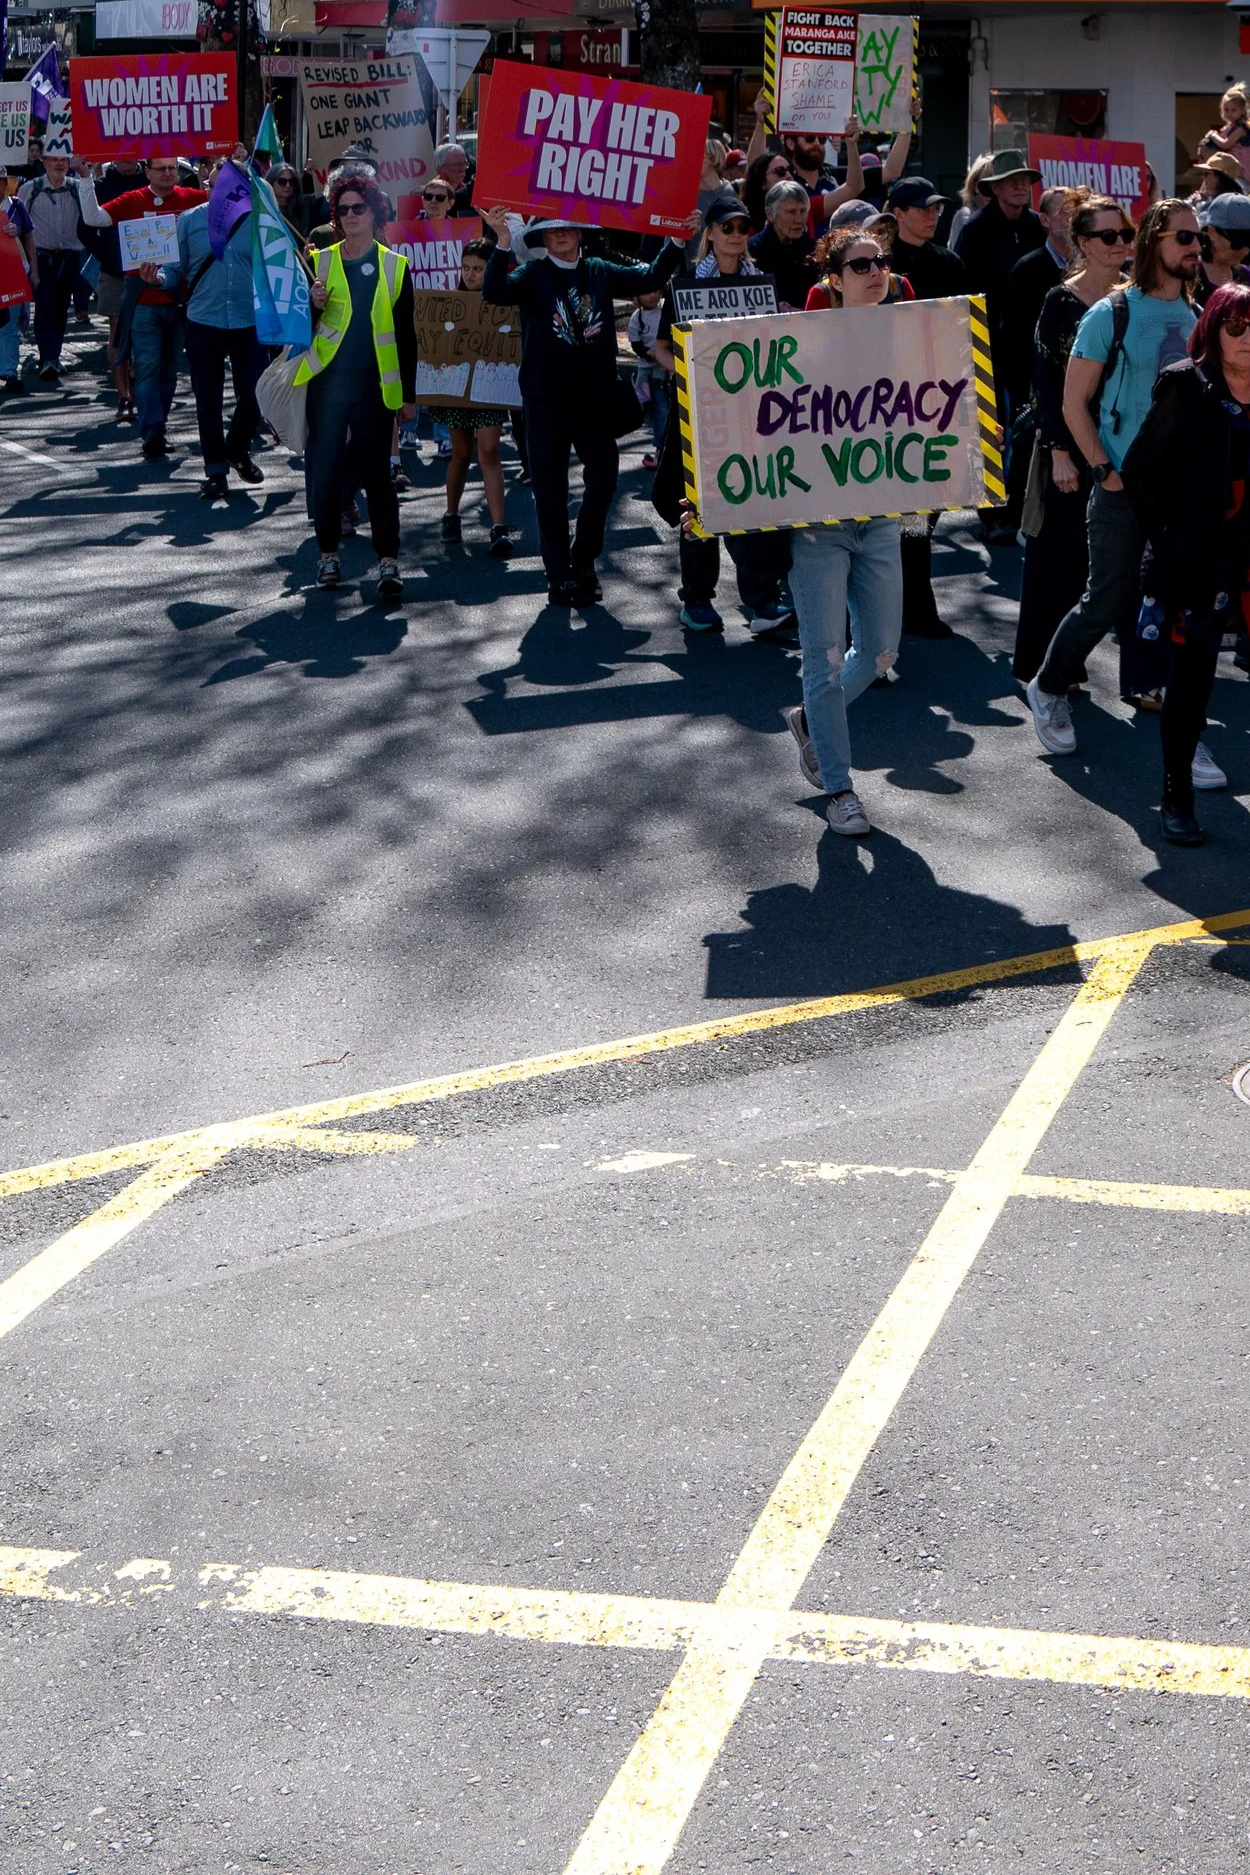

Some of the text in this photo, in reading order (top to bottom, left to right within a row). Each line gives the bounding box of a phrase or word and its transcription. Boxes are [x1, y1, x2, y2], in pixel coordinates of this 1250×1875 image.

[787, 12, 854, 28] FIGHT BACK
[785, 26, 855, 40] MARANGA AKE
[787, 40, 852, 56] TOGETHER
[304, 67, 358, 83] REVISED
[792, 63, 834, 77] ERICA
[84, 76, 179, 108] WOMEN
[184, 73, 228, 103] ARE
[784, 78, 848, 91] STANFORD
[311, 89, 390, 109] ONE GIANT
[791, 92, 836, 107] SHAME
[12, 113, 26, 128] US
[101, 105, 188, 137] WORTH
[193, 103, 213, 132] IT
[318, 117, 349, 139] LEAP
[524, 88, 680, 158] PAY HER
[5, 129, 25, 147] US
[536, 142, 654, 205] RIGHT
[1039, 159, 1141, 197] WOMEN ARE
[661, 218, 683, 228] Labour
[679, 286, 774, 310] ME ARO KOE
[454, 328, 522, 358] EQUIT
[714, 335, 804, 395] OUR
[756, 378, 969, 436] DEMOCRACY
[717, 446, 811, 505] OUR
